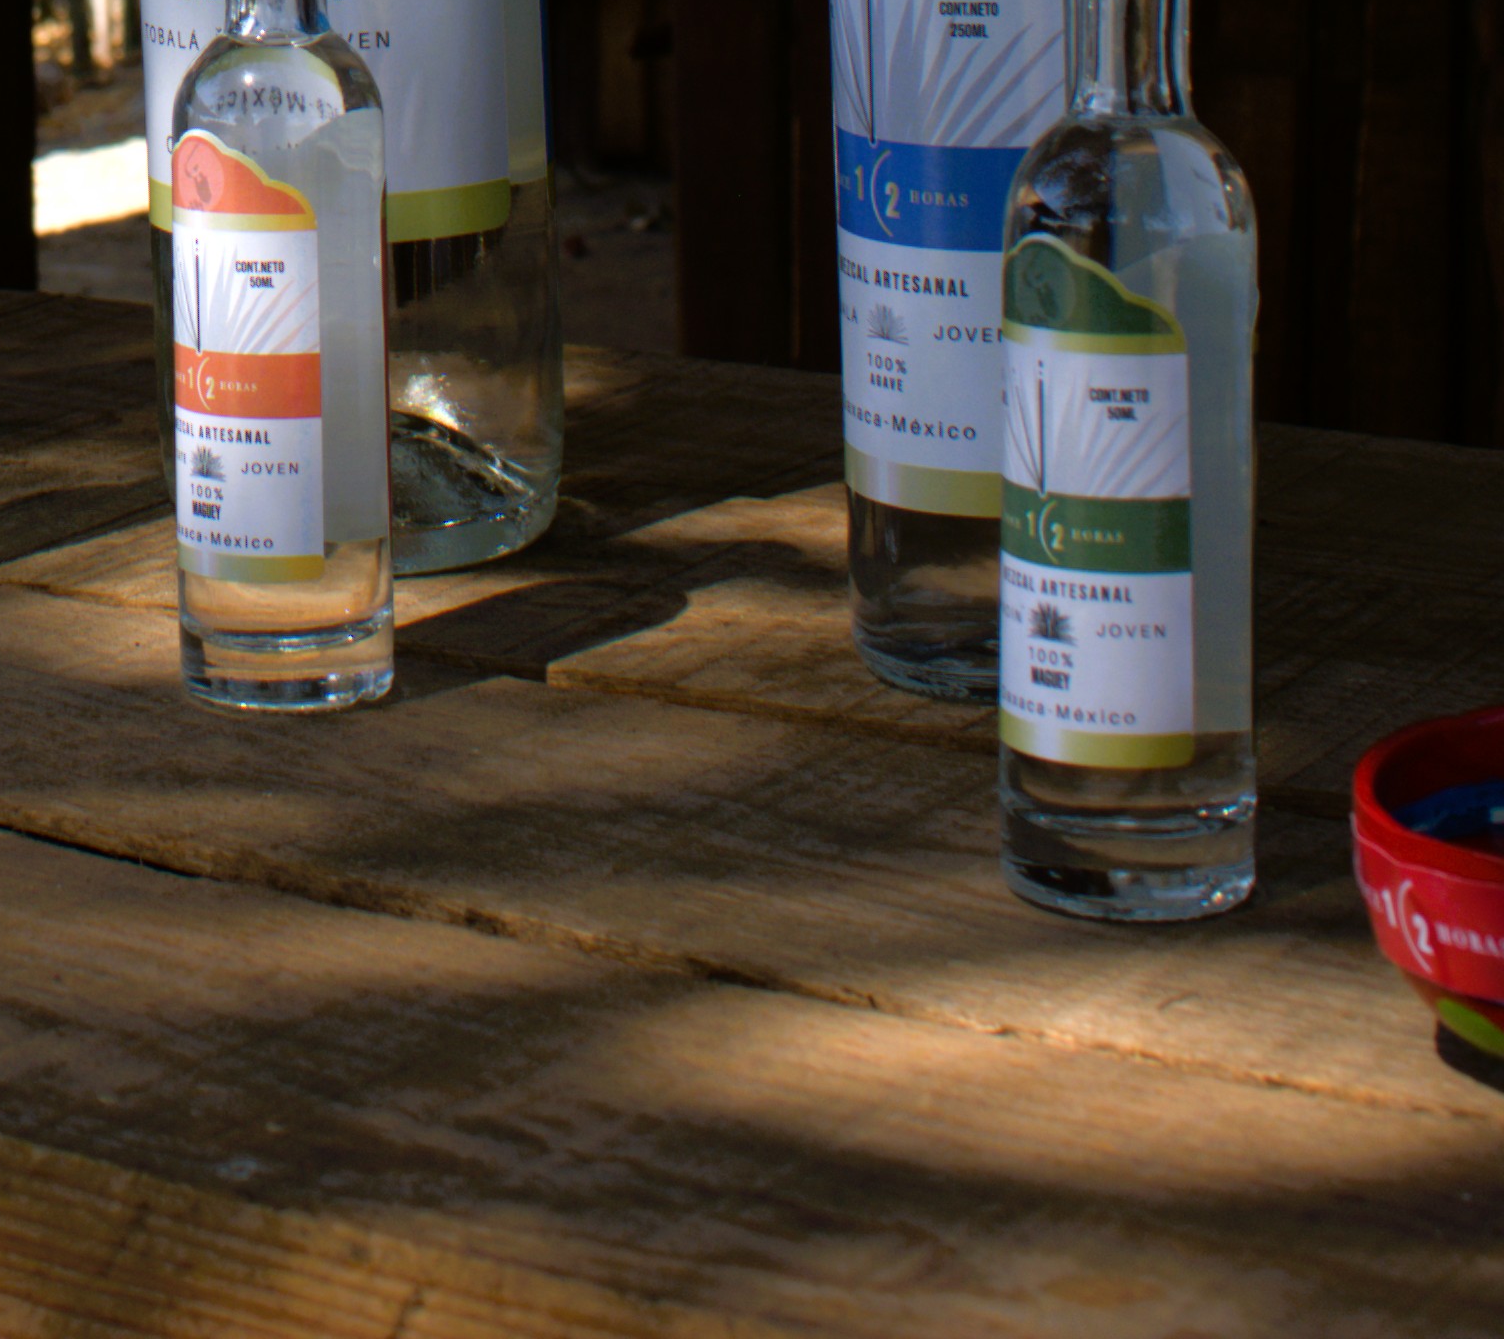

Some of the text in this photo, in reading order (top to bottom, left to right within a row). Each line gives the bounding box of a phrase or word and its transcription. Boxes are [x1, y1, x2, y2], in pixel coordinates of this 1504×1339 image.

[939, 1, 999, 16] CONT.NETO
[950, 24, 989, 38] 250ML
[909, 190, 969, 206] HORAS
[236, 260, 285, 273] CONT.NETO
[250, 277, 274, 288] 50ML
[874, 269, 969, 297] ARTESANAL
[867, 352, 907, 374] 100%
[220, 380, 258, 392] HORAS
[870, 373, 903, 393] AGAVE
[1089, 388, 1149, 403] CONT.NETO
[199, 425, 271, 445] ARTESANAL
[242, 462, 299, 474] JOVEN
[191, 483, 223, 500] 100%
[192, 501, 220, 520] MAGUEY
[1040, 579, 1133, 603] ARTESANAL
[1096, 623, 1167, 638] JOVEN
[1029, 646, 1073, 667] 100%
